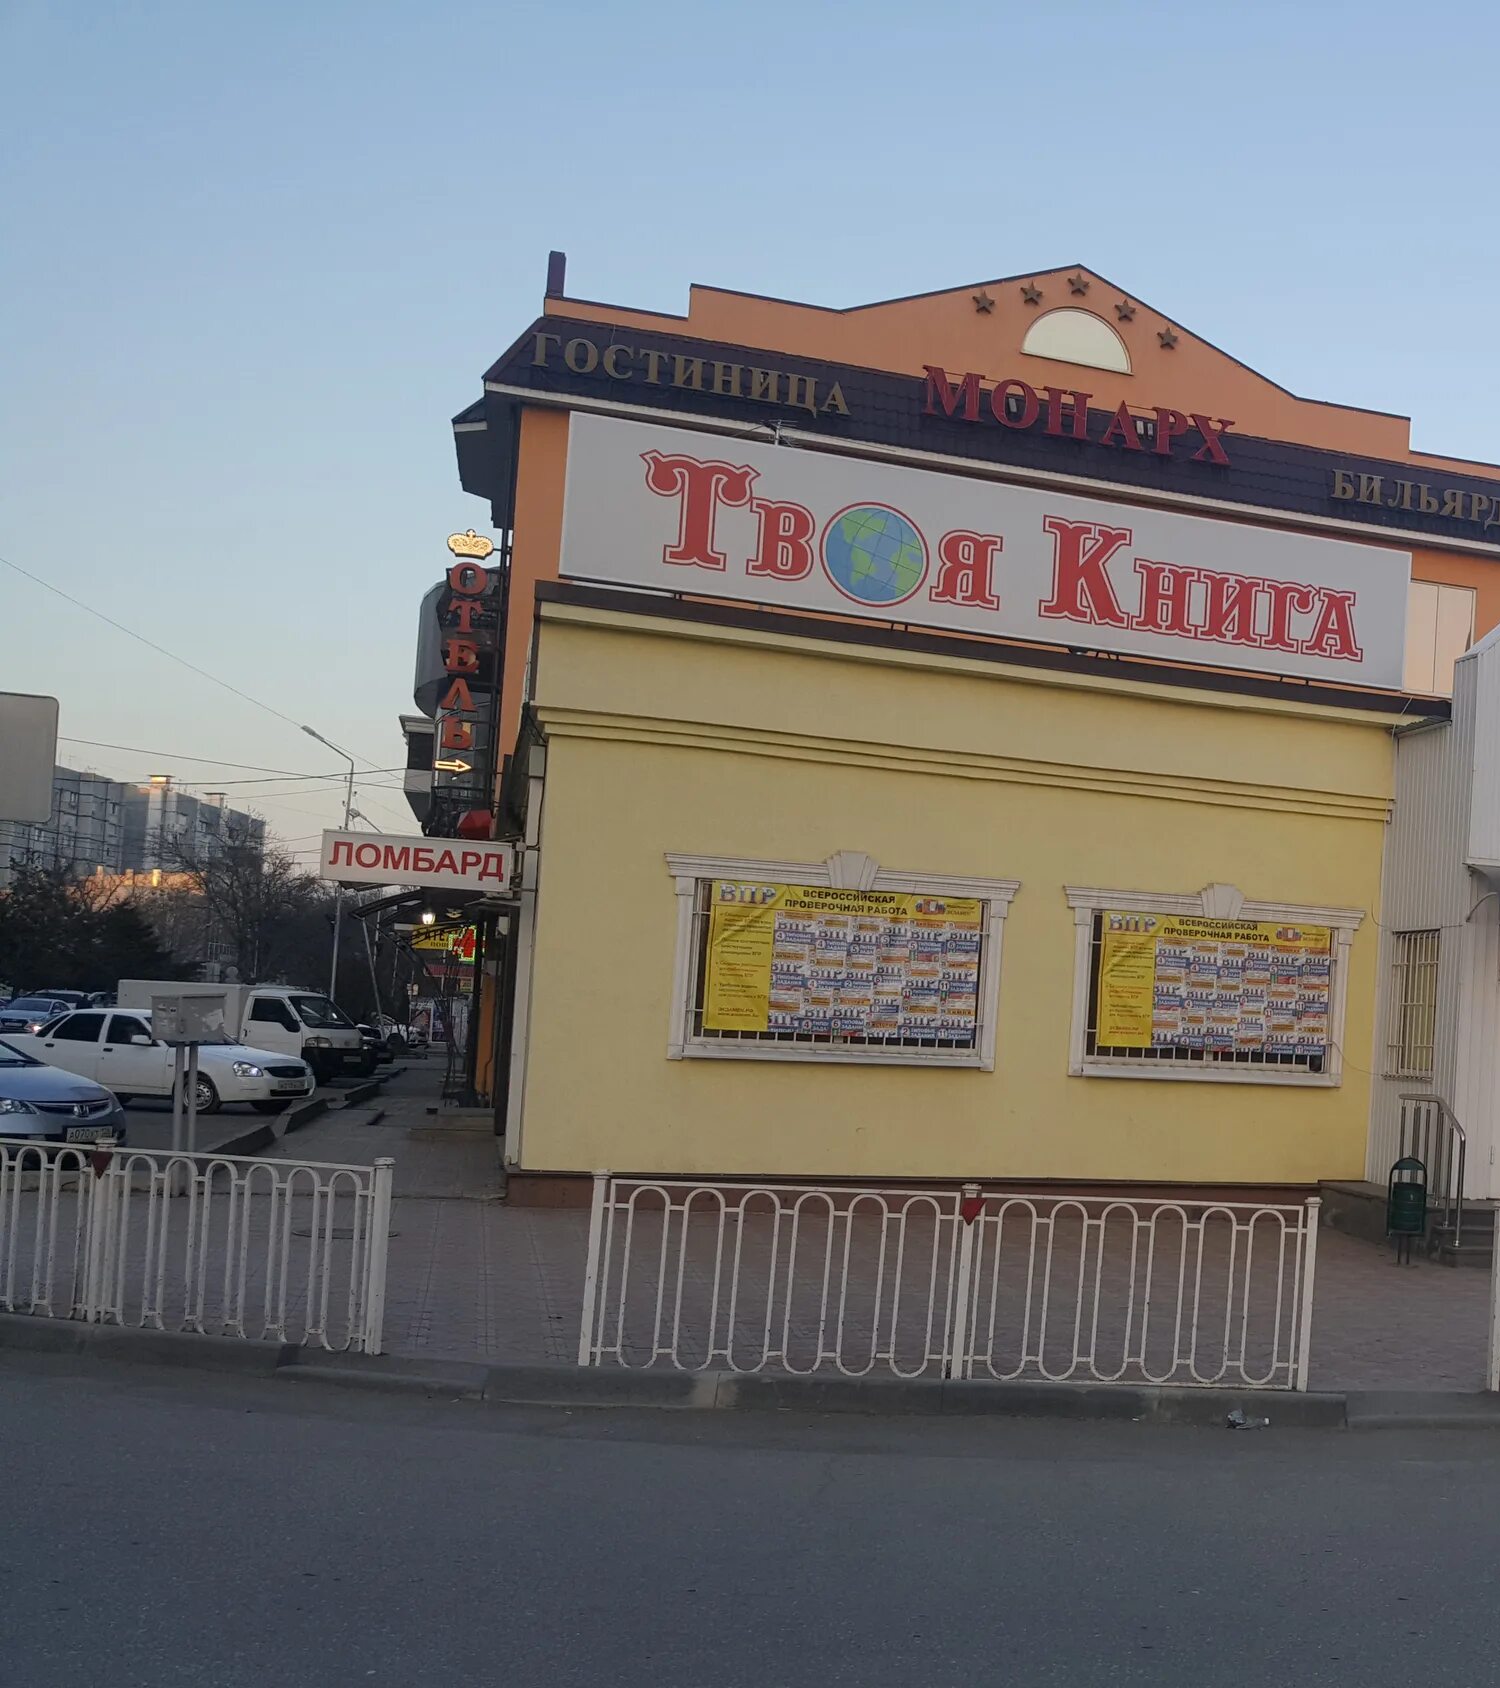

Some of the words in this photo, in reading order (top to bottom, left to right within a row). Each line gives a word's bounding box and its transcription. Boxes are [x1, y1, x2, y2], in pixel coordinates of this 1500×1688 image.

[529, 332, 851, 418] ГОСТИНИЦА
[922, 364, 1236, 466] МОНАРХ
[440, 562, 488, 750] ОТЕЛЬ
[328, 841, 504, 883] ЛОМБАРД
[719, 883, 776, 905] ВПР
[803, 889, 896, 904] ВСЕРОССИЙСКАЯ
[785, 899, 865, 913] ПРОВЕРОЧНАЯ
[867, 904, 908, 916] РАБОТА
[1109, 914, 1156, 933] ВПР
[1179, 918, 1259, 931] ВСЕРОССИЙСКАЯ
[1164, 927, 1233, 941] ПРОВЕРОЧНАЯ
[1235, 932, 1270, 943] РАБОТА
